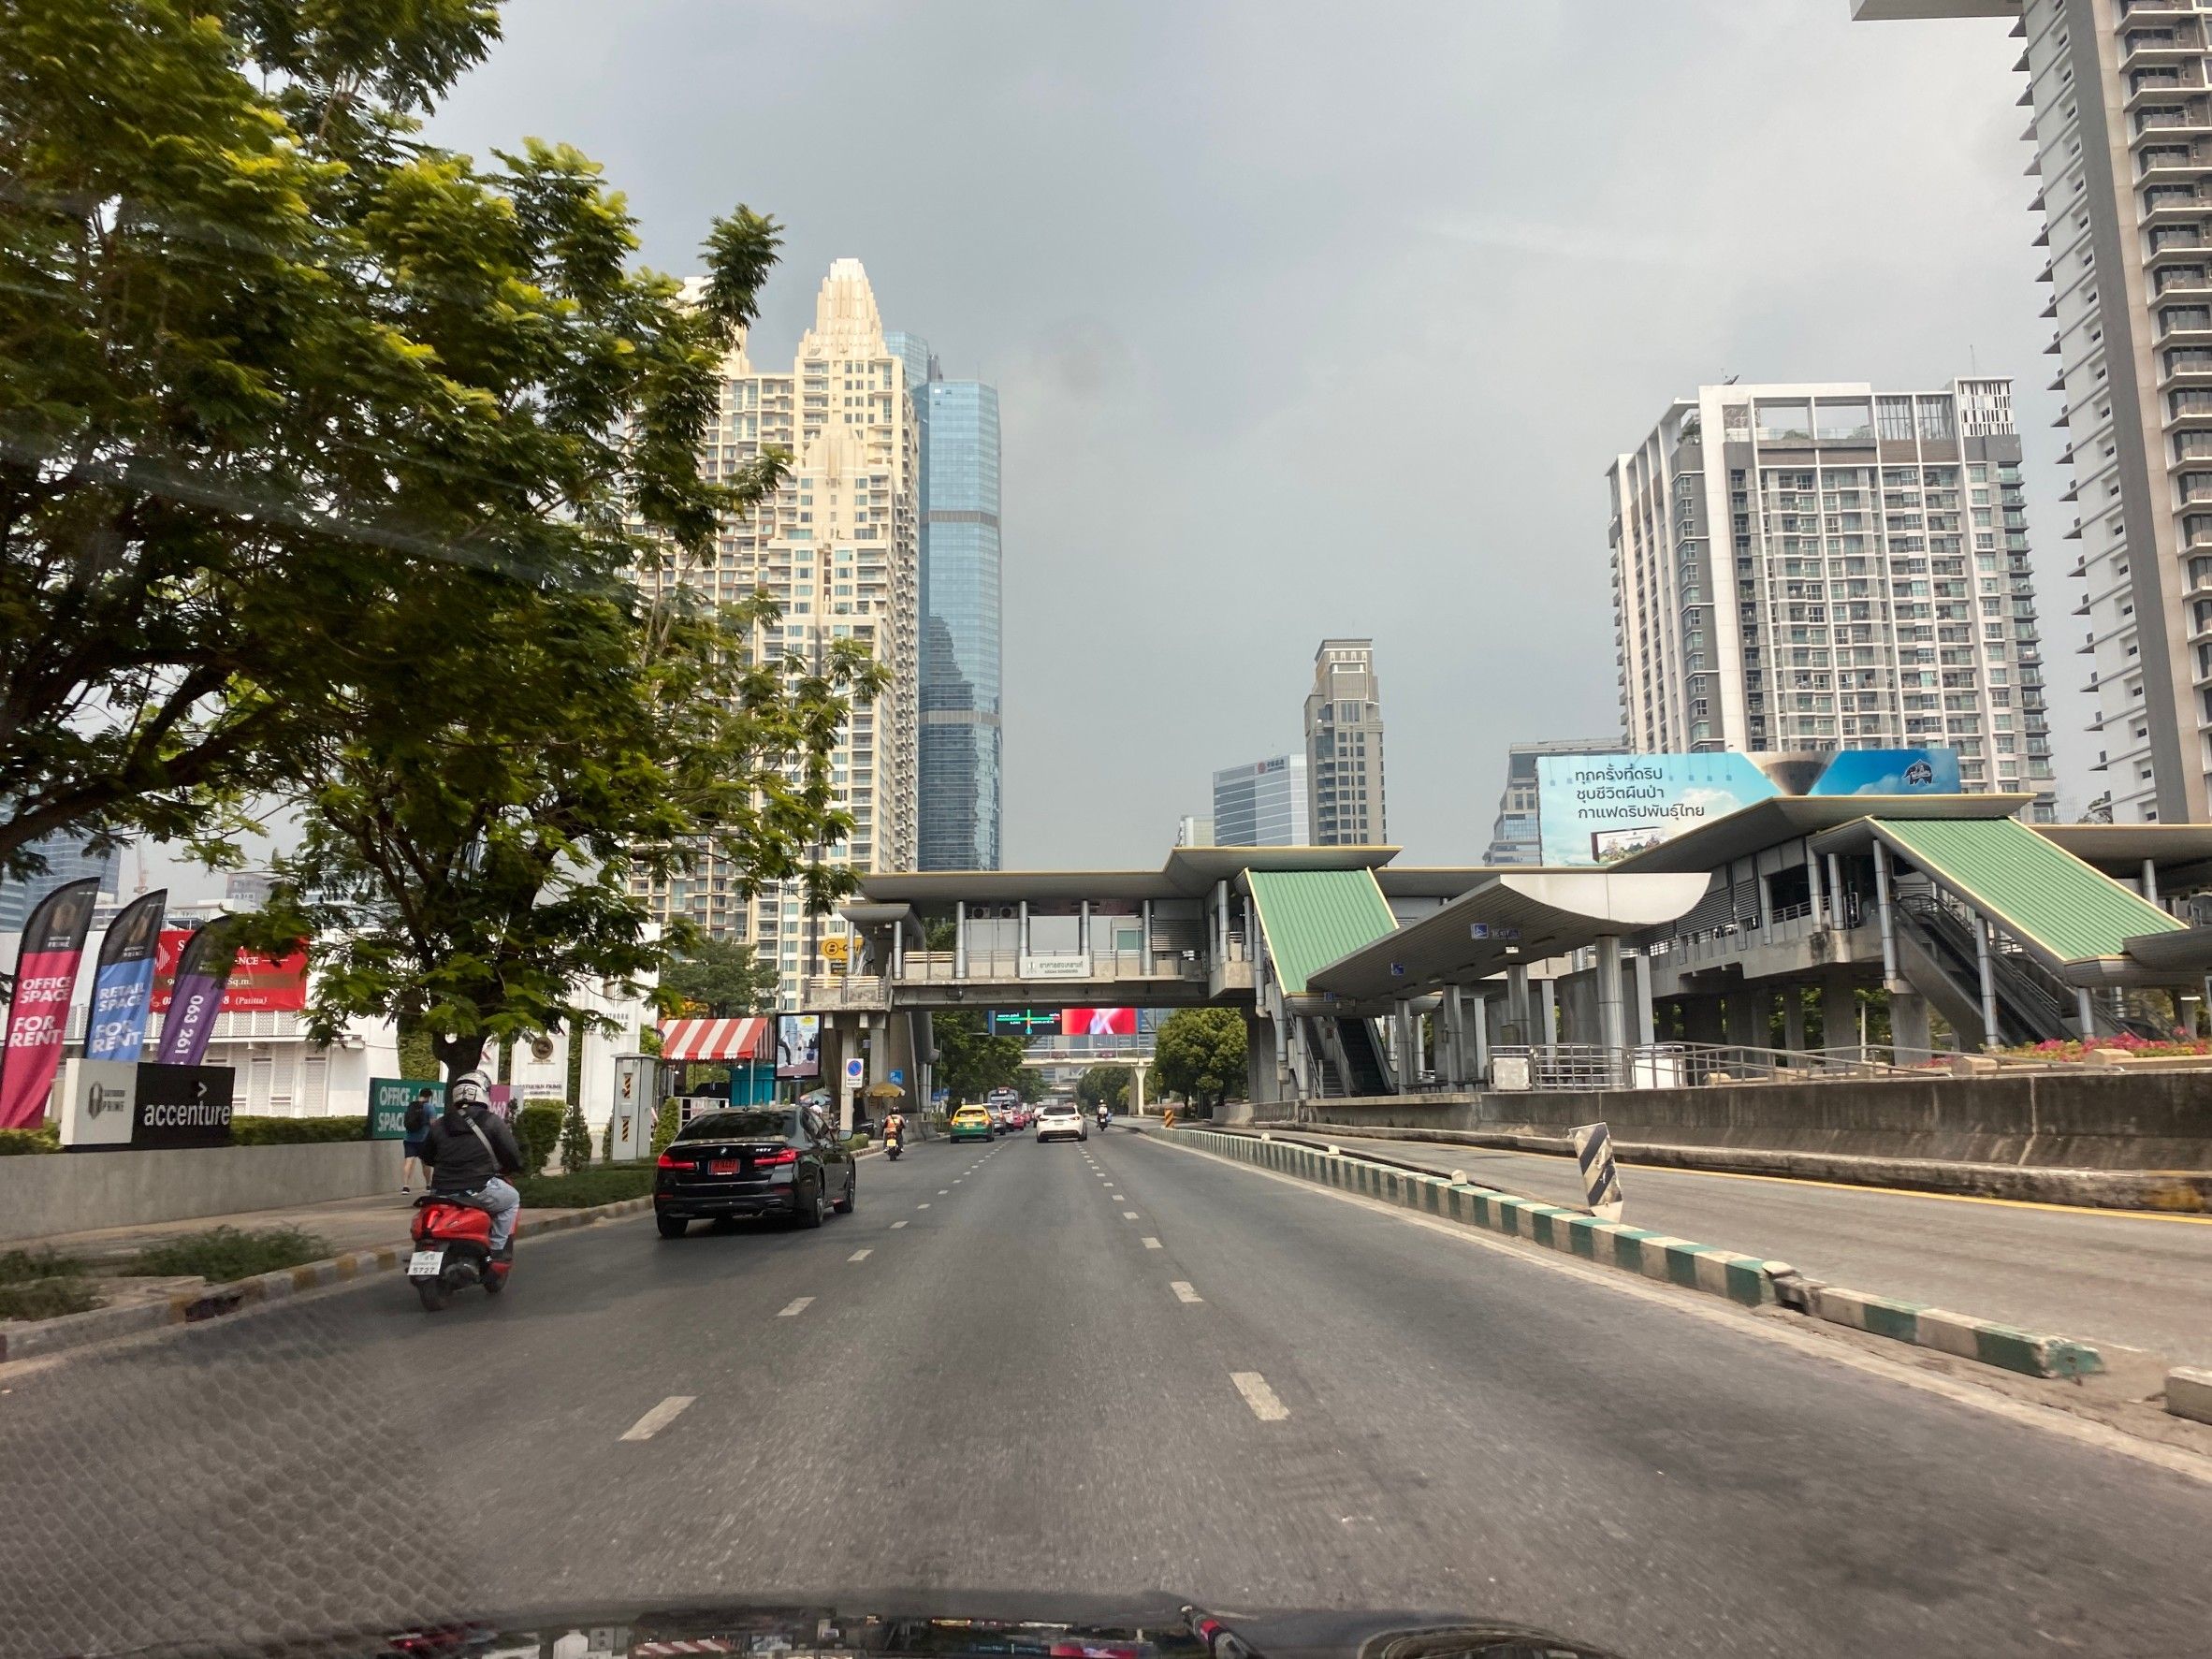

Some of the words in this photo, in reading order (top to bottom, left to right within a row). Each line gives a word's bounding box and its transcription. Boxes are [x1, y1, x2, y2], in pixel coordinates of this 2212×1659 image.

[1575, 763, 1663, 784] ทุกครั้งที่ดริป
[1577, 785, 1665, 803] ชุบชีวิตผืนป่า
[1579, 803, 1705, 821] กาแฟดริปพันธุ์ไทย
[22, 977, 71, 990] OFFICE
[99, 982, 144, 999] RETAIL
[21, 988, 70, 1004] SPACE
[98, 995, 143, 1011] SPACE
[183, 995, 204, 1024] 063
[14, 1015, 54, 1032] FOR
[95, 1020, 135, 1038] FOR
[8, 1030, 61, 1047] RENT
[92, 1032, 140, 1054] RENT
[174, 1028, 195, 1054] 261
[379, 1086, 410, 1106] OFFICE
[144, 1100, 231, 1126] accenture
